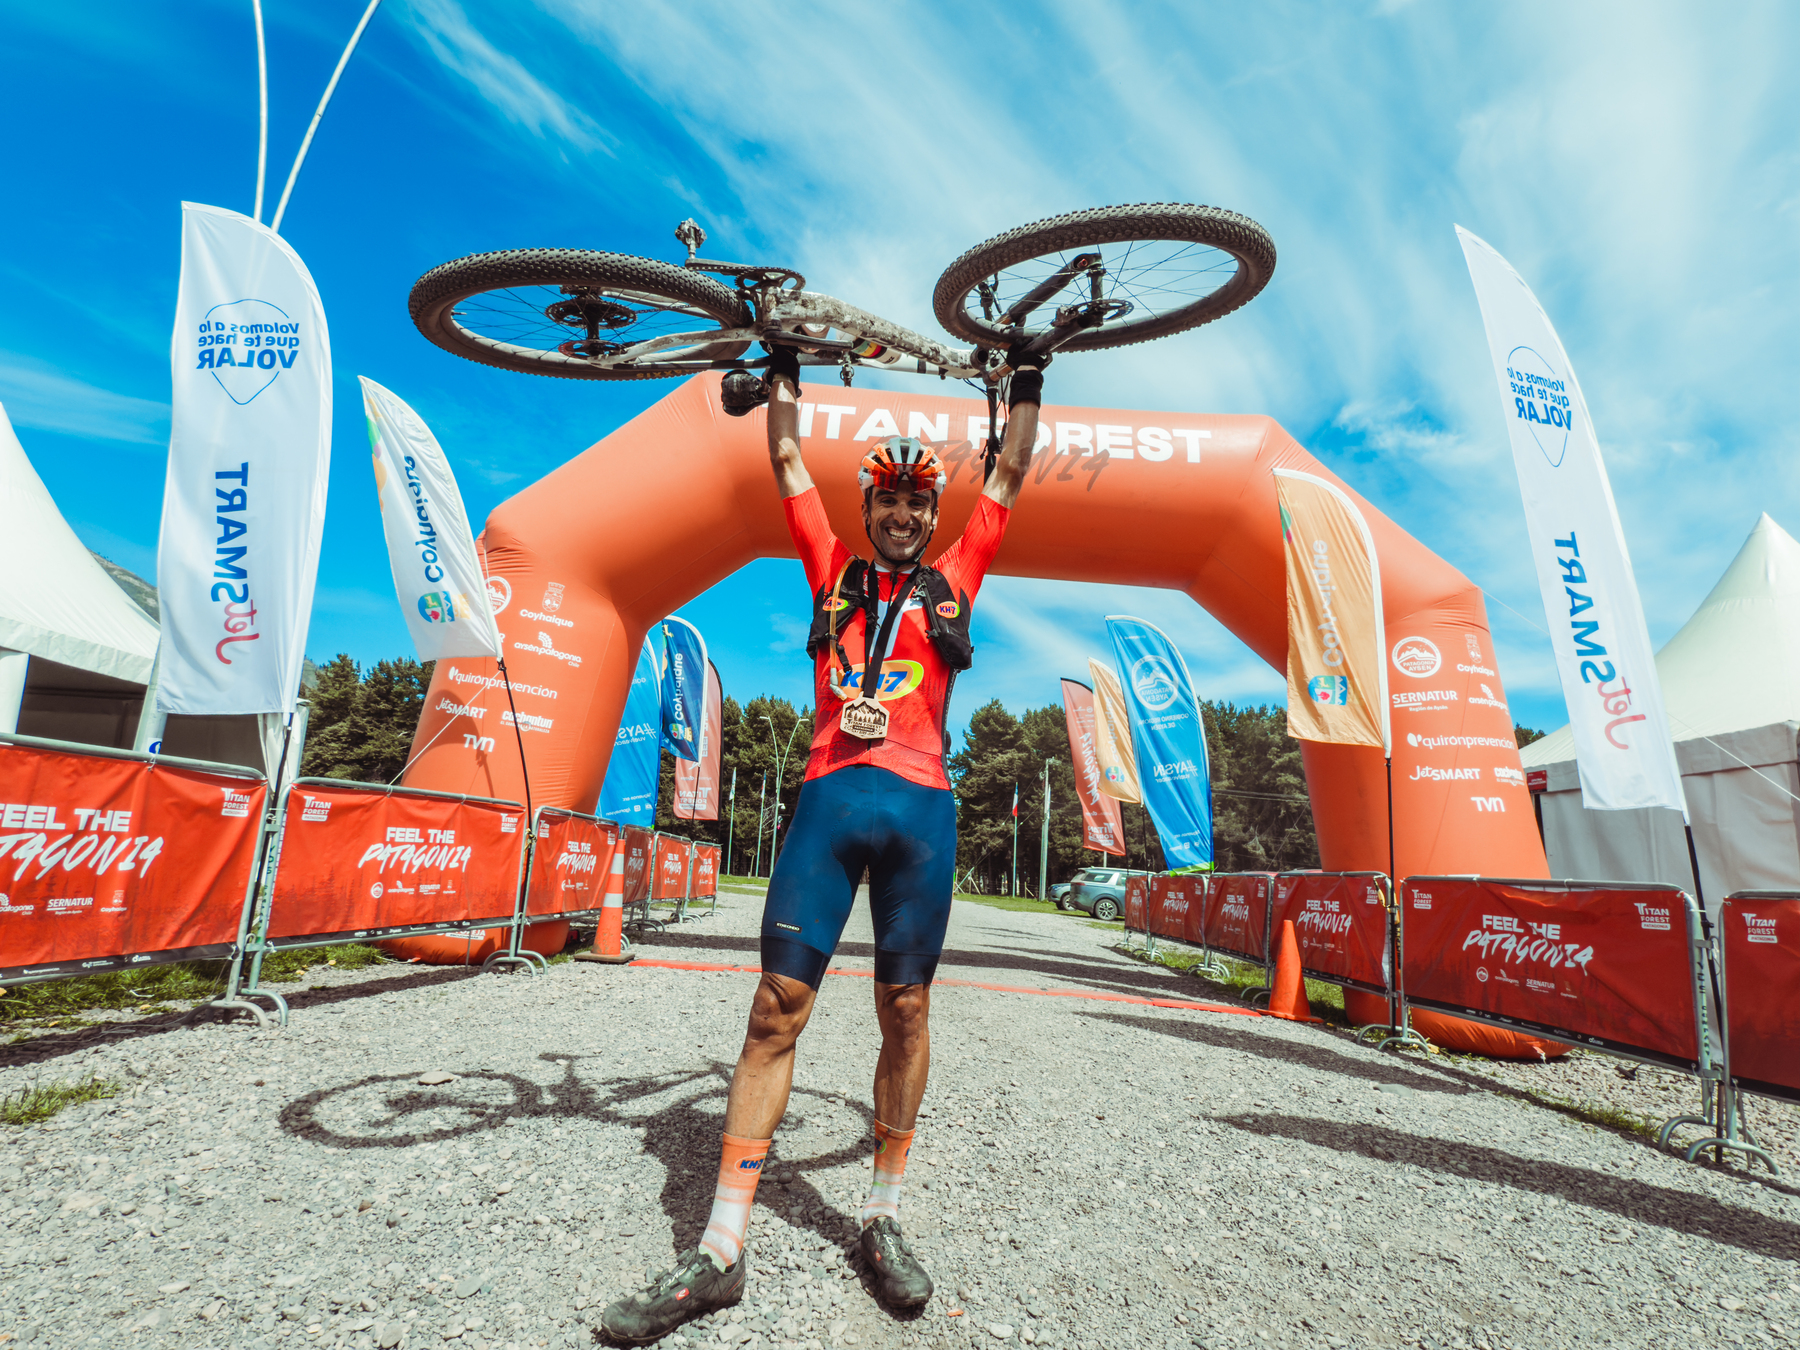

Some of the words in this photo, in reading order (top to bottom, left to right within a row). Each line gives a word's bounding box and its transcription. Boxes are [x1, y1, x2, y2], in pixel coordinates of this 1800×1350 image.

[762, 402, 950, 443] ITAN
[520, 609, 574, 628] Coyhaique
[1392, 690, 1458, 704] SERNATUR
[1410, 766, 1480, 781] JetSMART
[221, 788, 250, 803] TITAN
[303, 796, 332, 809] TITAN
[74, 808, 132, 832] THE
[386, 827, 424, 843] FEEL
[428, 829, 456, 844] THE
[0, 833, 164, 882] TAGONIA
[358, 843, 472, 874] PATAGONIA
[1412, 890, 1432, 899] TITAN
[48, 897, 94, 908] SERNATUR
[1306, 900, 1323, 911] FEEL
[1324, 900, 1339, 912] THE
[1634, 902, 1670, 916] TITAN
[1482, 914, 1524, 934] FEEL
[1742, 913, 1776, 926] TITAN
[1462, 930, 1594, 976] PATAGONIA
[1526, 978, 1555, 989] SERNATUR
